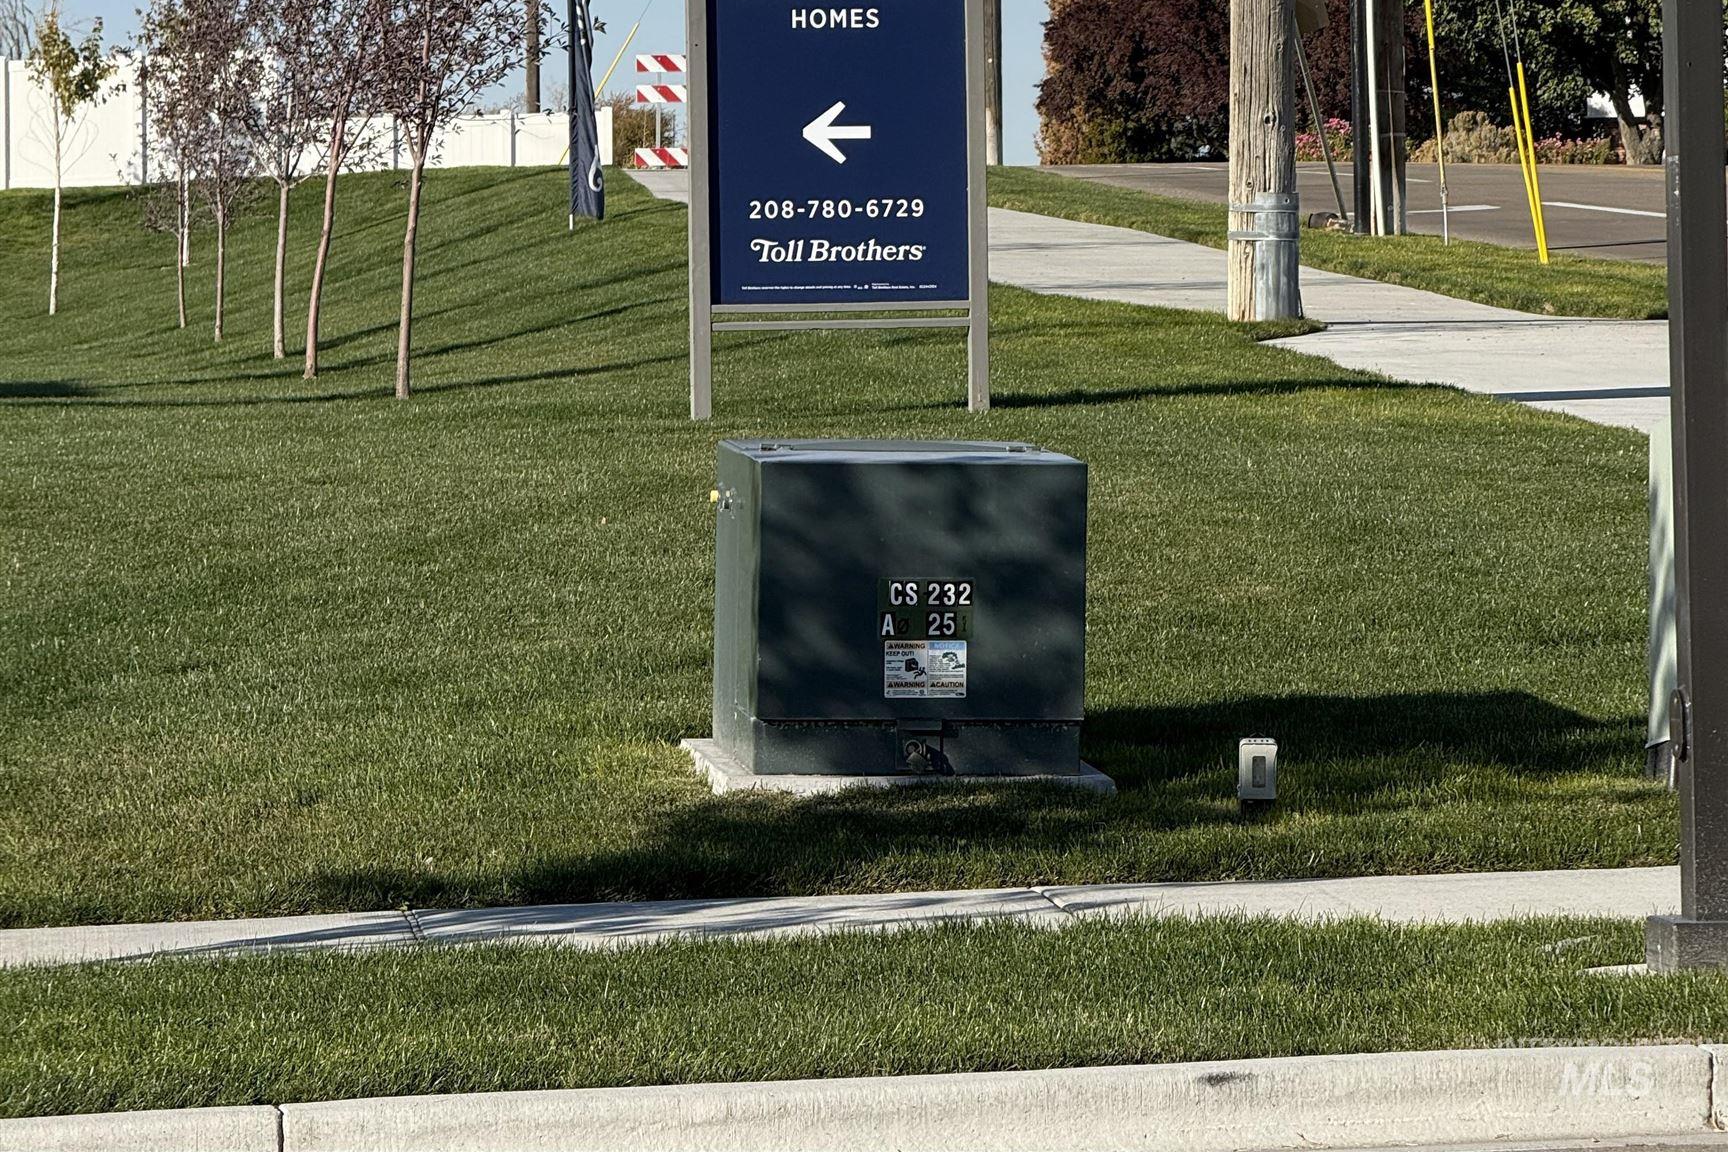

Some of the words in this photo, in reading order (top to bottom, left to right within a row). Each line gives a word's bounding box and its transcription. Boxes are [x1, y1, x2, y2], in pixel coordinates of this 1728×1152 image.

[791, 8, 880, 29] HOMES
[749, 198, 924, 219] 208-780-6729
[750, 238, 804, 263] Toll
[808, 238, 924, 262] Brothers
[890, 582, 918, 606] CS
[928, 583, 971, 606] 232
[881, 613, 895, 636] A
[928, 612, 955, 636] 25
